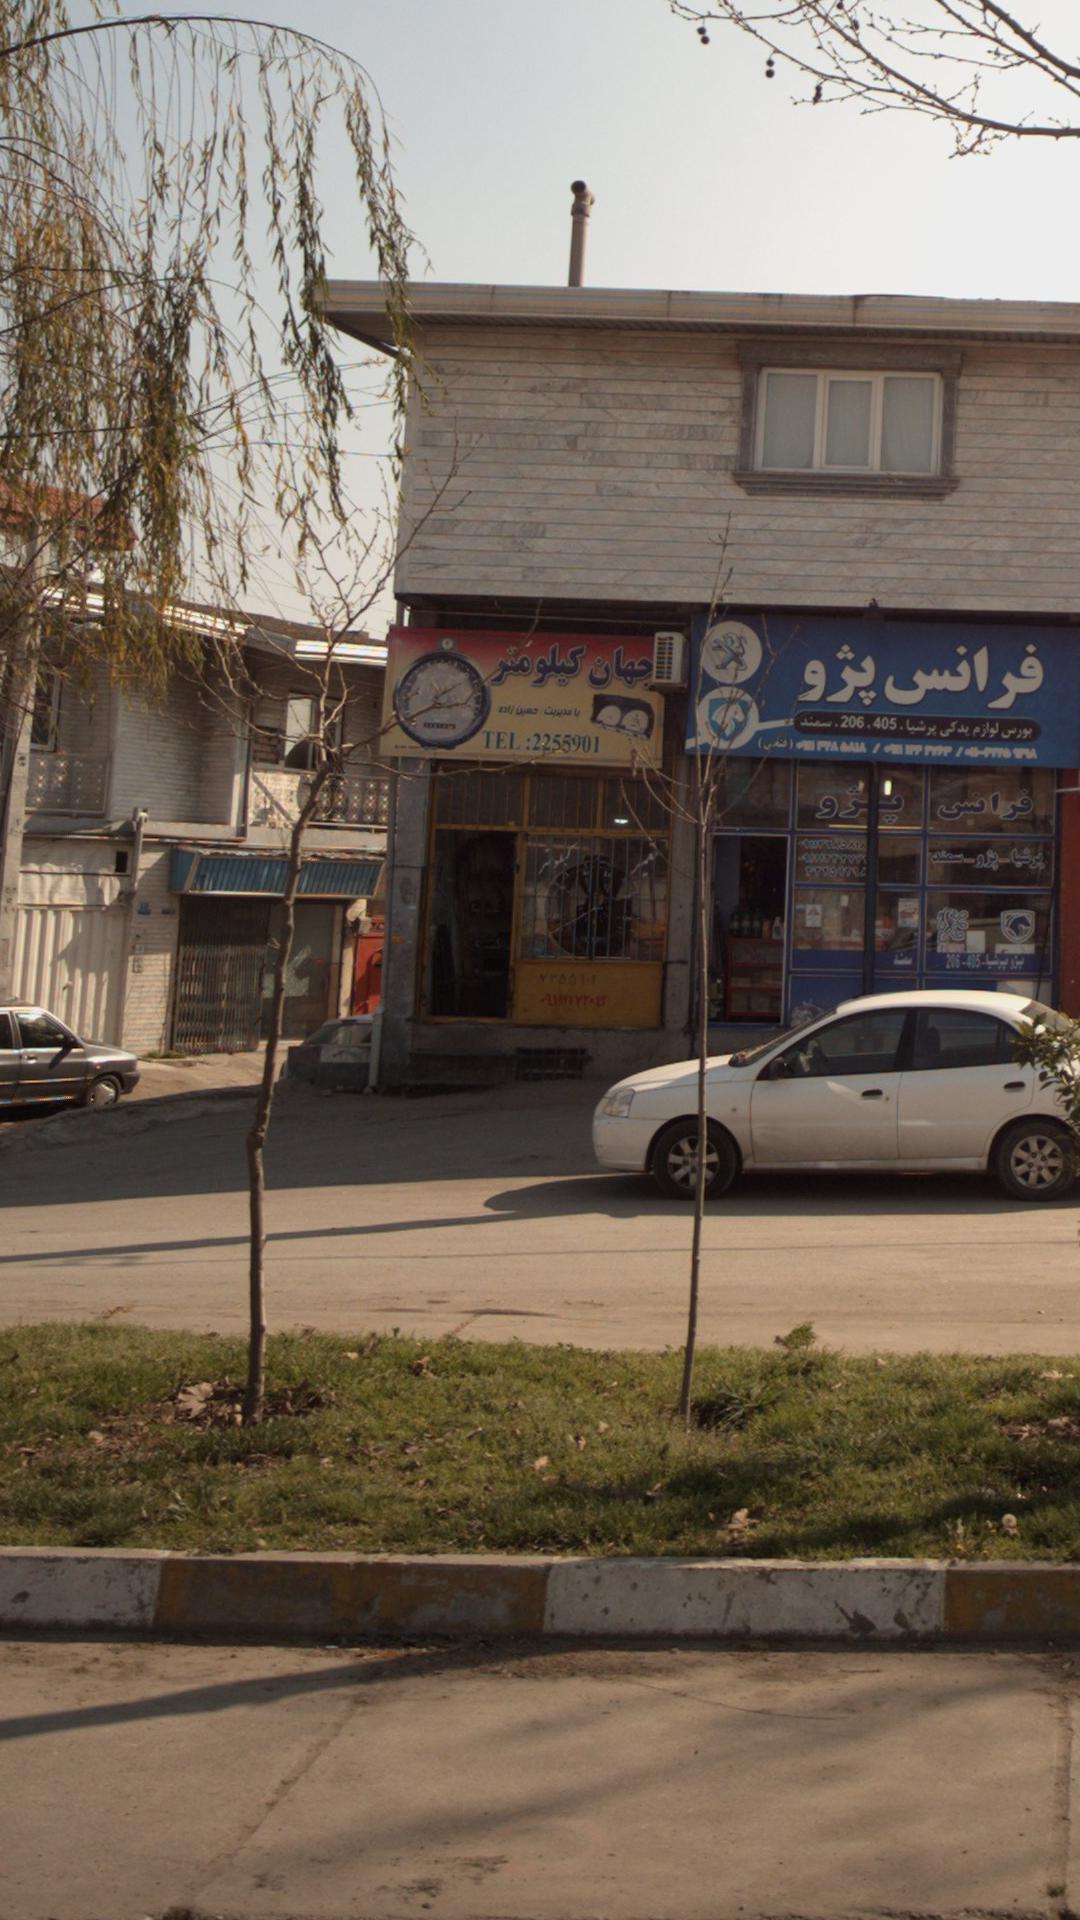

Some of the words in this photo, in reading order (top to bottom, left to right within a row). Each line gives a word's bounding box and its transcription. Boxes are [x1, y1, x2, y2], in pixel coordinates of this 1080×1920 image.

[588, 645, 653, 689] جهان
[798, 642, 876, 706] پژو
[883, 642, 1044, 709] فرانس
[544, 705, 573, 717] مدیریت
[574, 706, 581, 717] با
[801, 716, 833, 728] سمند
[841, 715, 865, 729] 206
[873, 717, 897, 730] 405
[906, 719, 937, 736] پرشیا
[940, 720, 969, 737] یدکی
[973, 721, 1000, 738] لوازم
[483, 731, 521, 750] TEL
[1001, 726, 1033, 739] بورس
[815, 784, 905, 824] پژو
[937, 787, 1033, 821] فرانس
